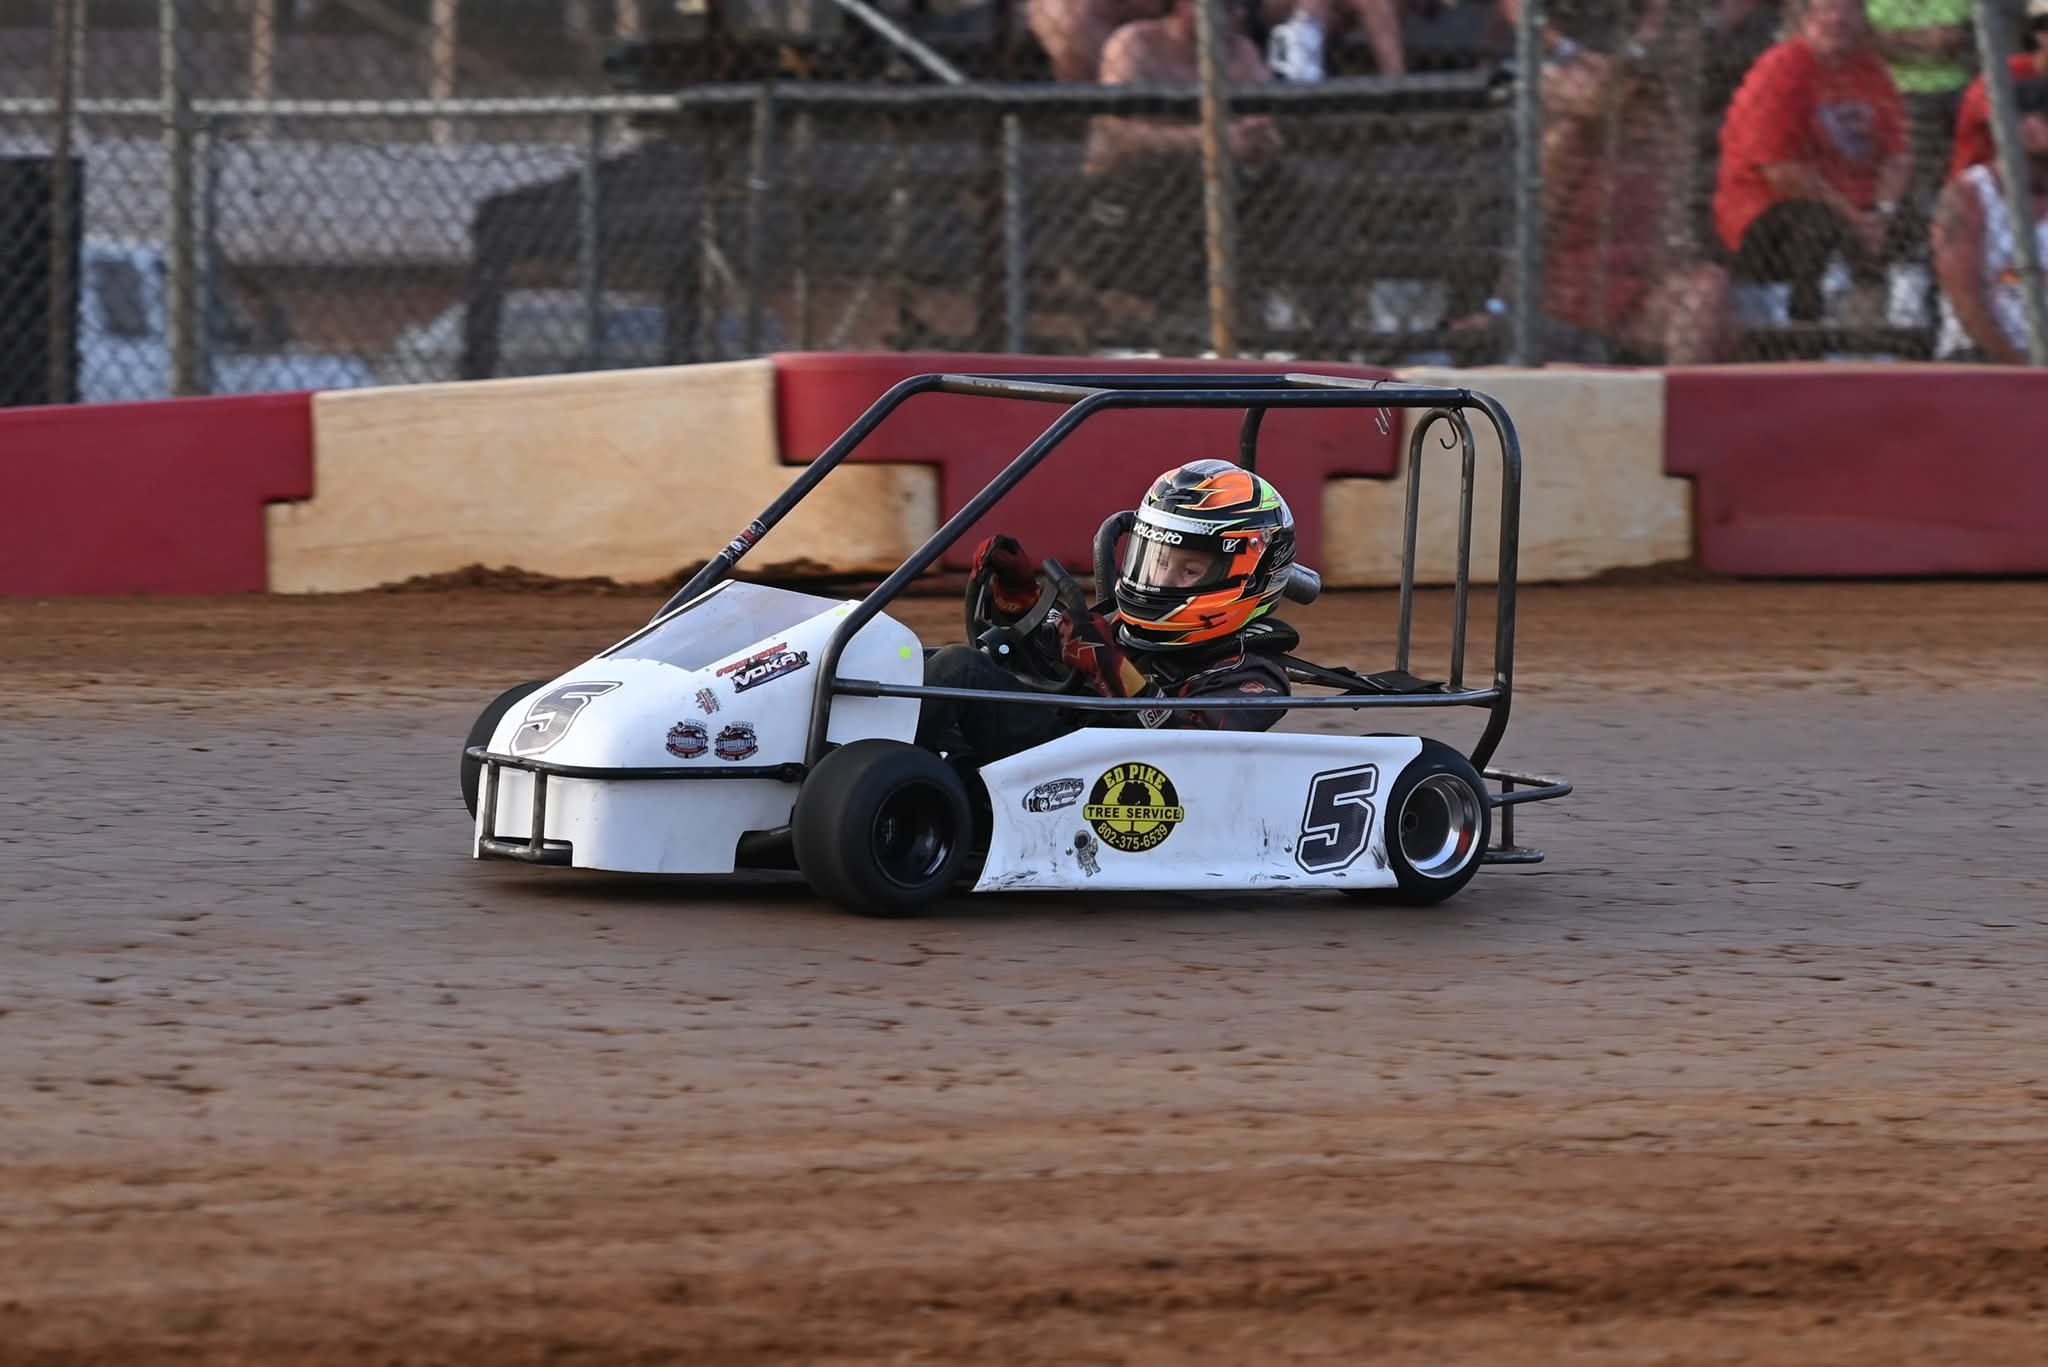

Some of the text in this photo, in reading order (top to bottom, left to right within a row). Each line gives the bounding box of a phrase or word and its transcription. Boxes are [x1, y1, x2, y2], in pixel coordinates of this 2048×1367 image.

[509, 680, 623, 756] 5
[1103, 764, 1166, 790] ED PIKE
[1087, 806, 1180, 820] TREE SERVICE
[1295, 763, 1379, 875] 5
[1097, 822, 1168, 850] 802-375-6539
